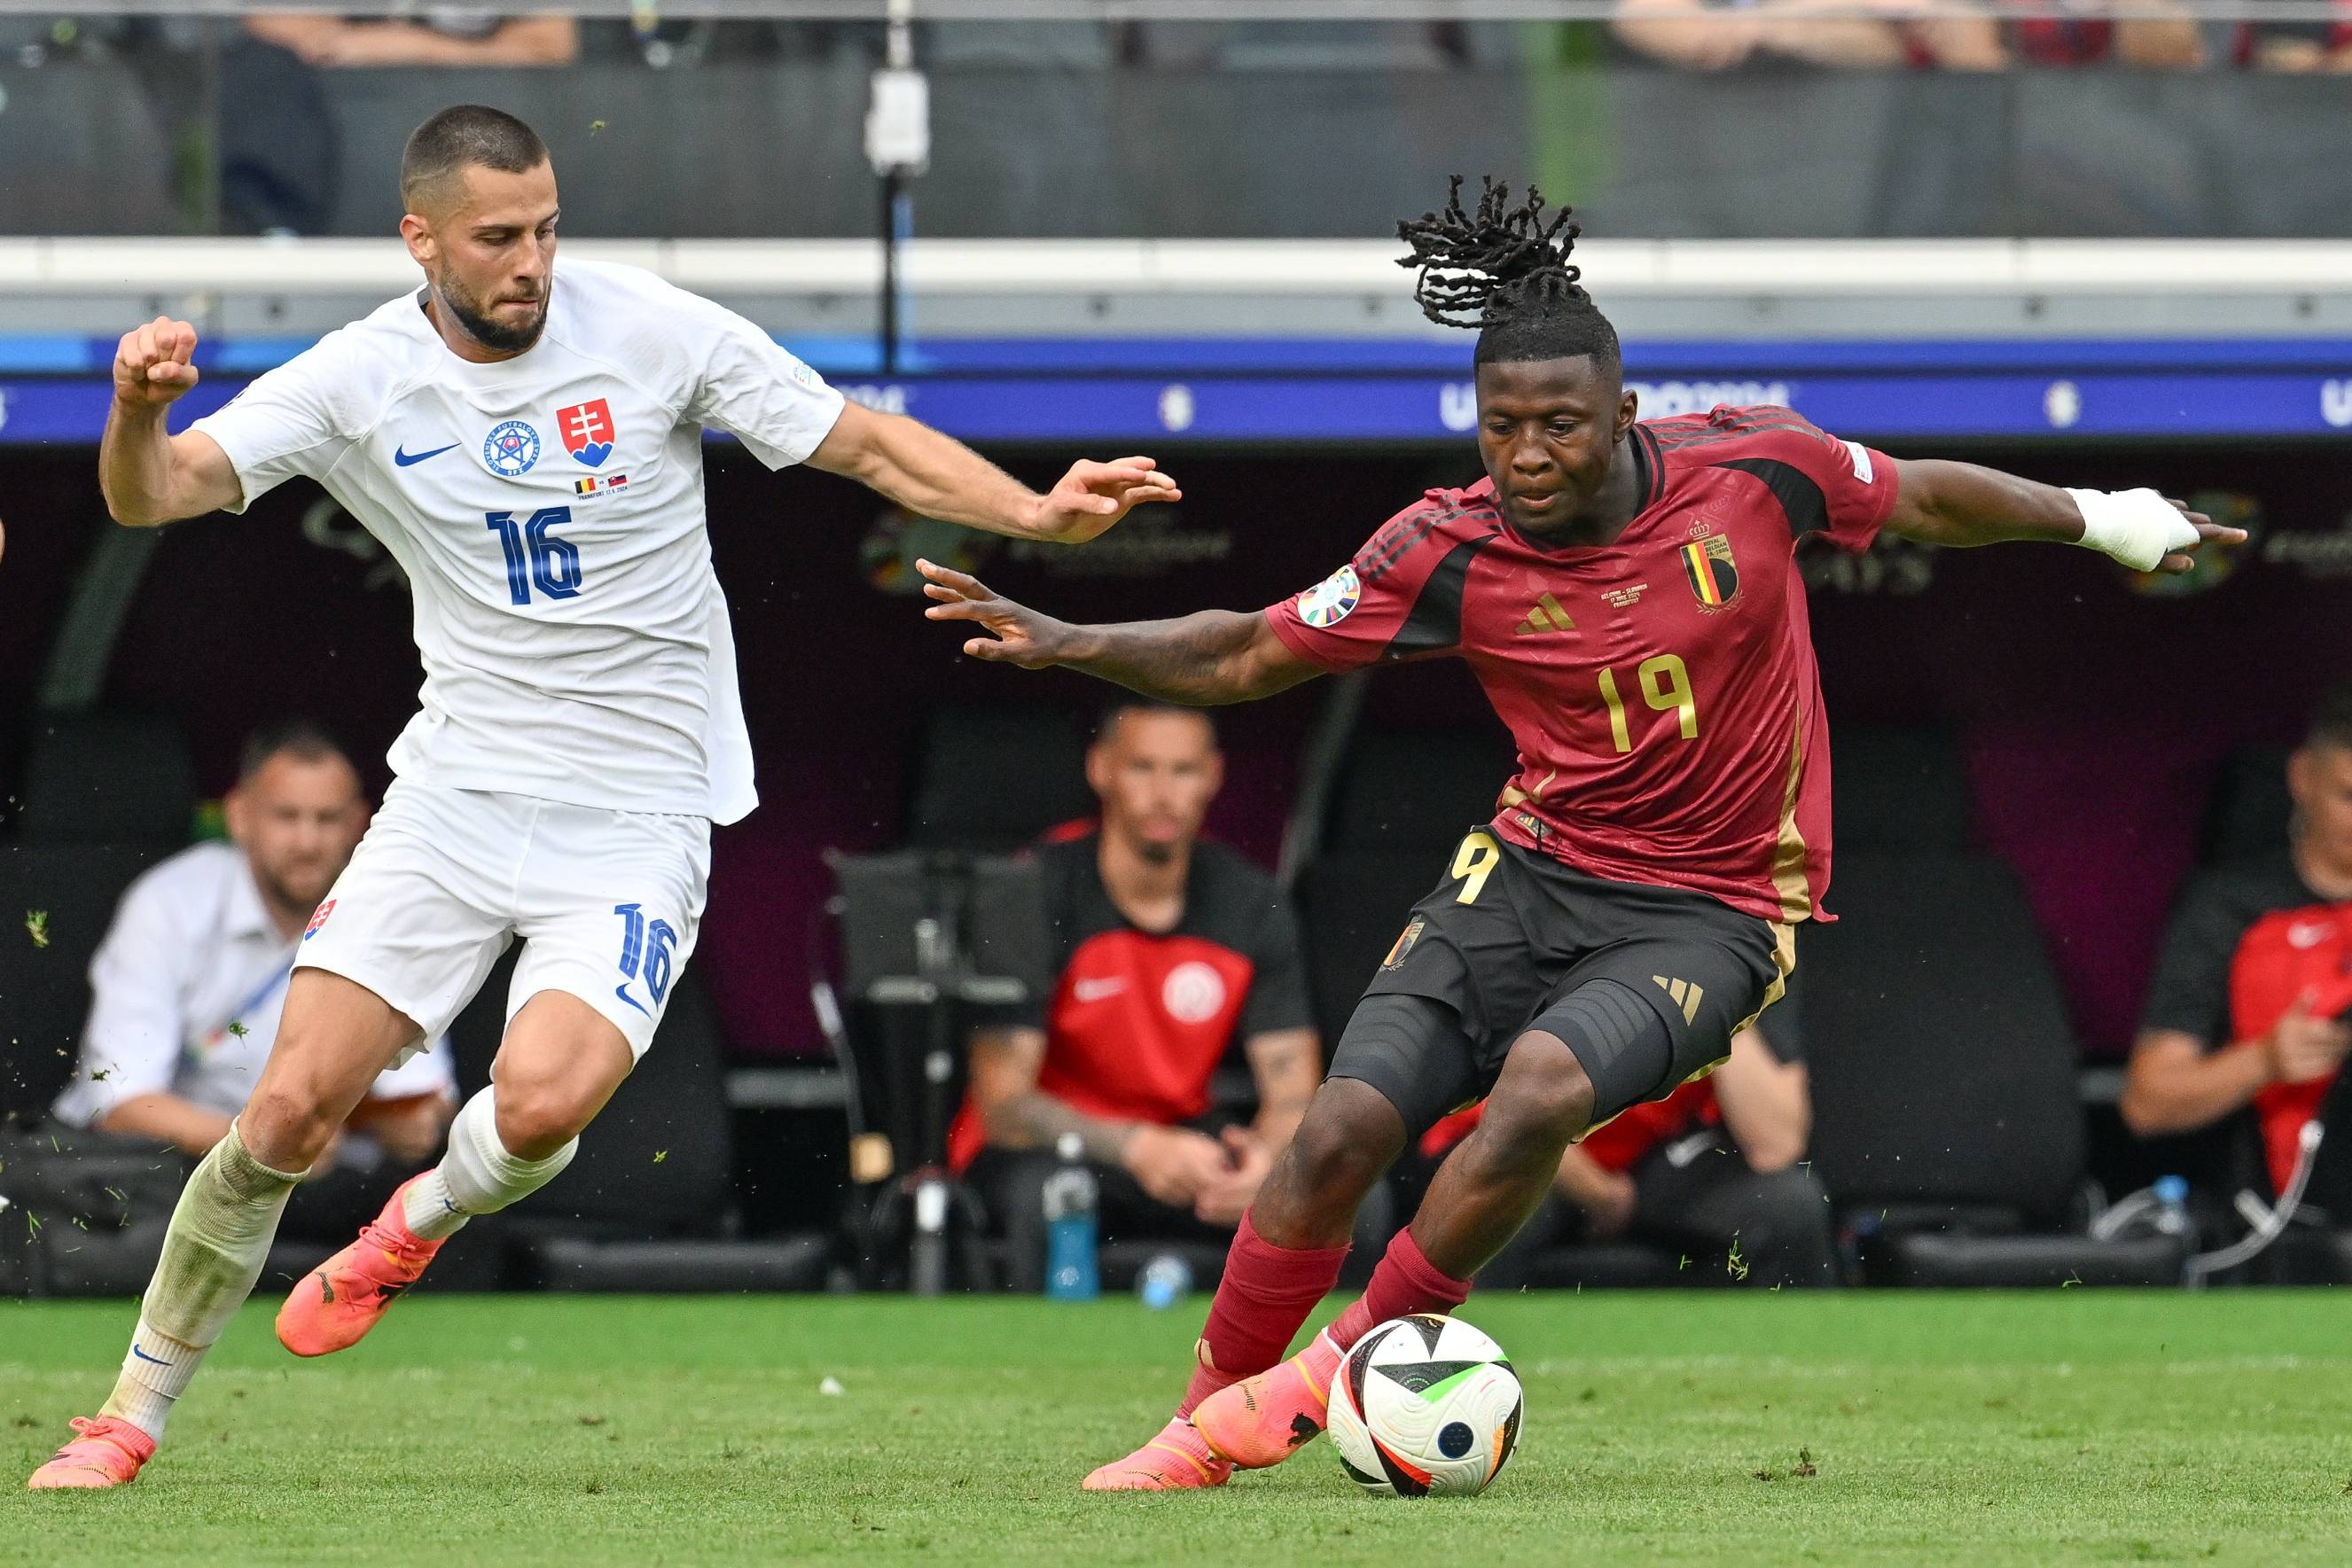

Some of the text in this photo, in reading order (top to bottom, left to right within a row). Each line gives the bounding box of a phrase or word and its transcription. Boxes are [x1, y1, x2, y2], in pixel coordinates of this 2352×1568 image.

[485, 506, 582, 605] 16
[1703, 537, 1720, 547] ROYAL
[1598, 653, 1699, 753] 19
[1451, 831, 1500, 905] 9
[613, 902, 676, 1008] 16
